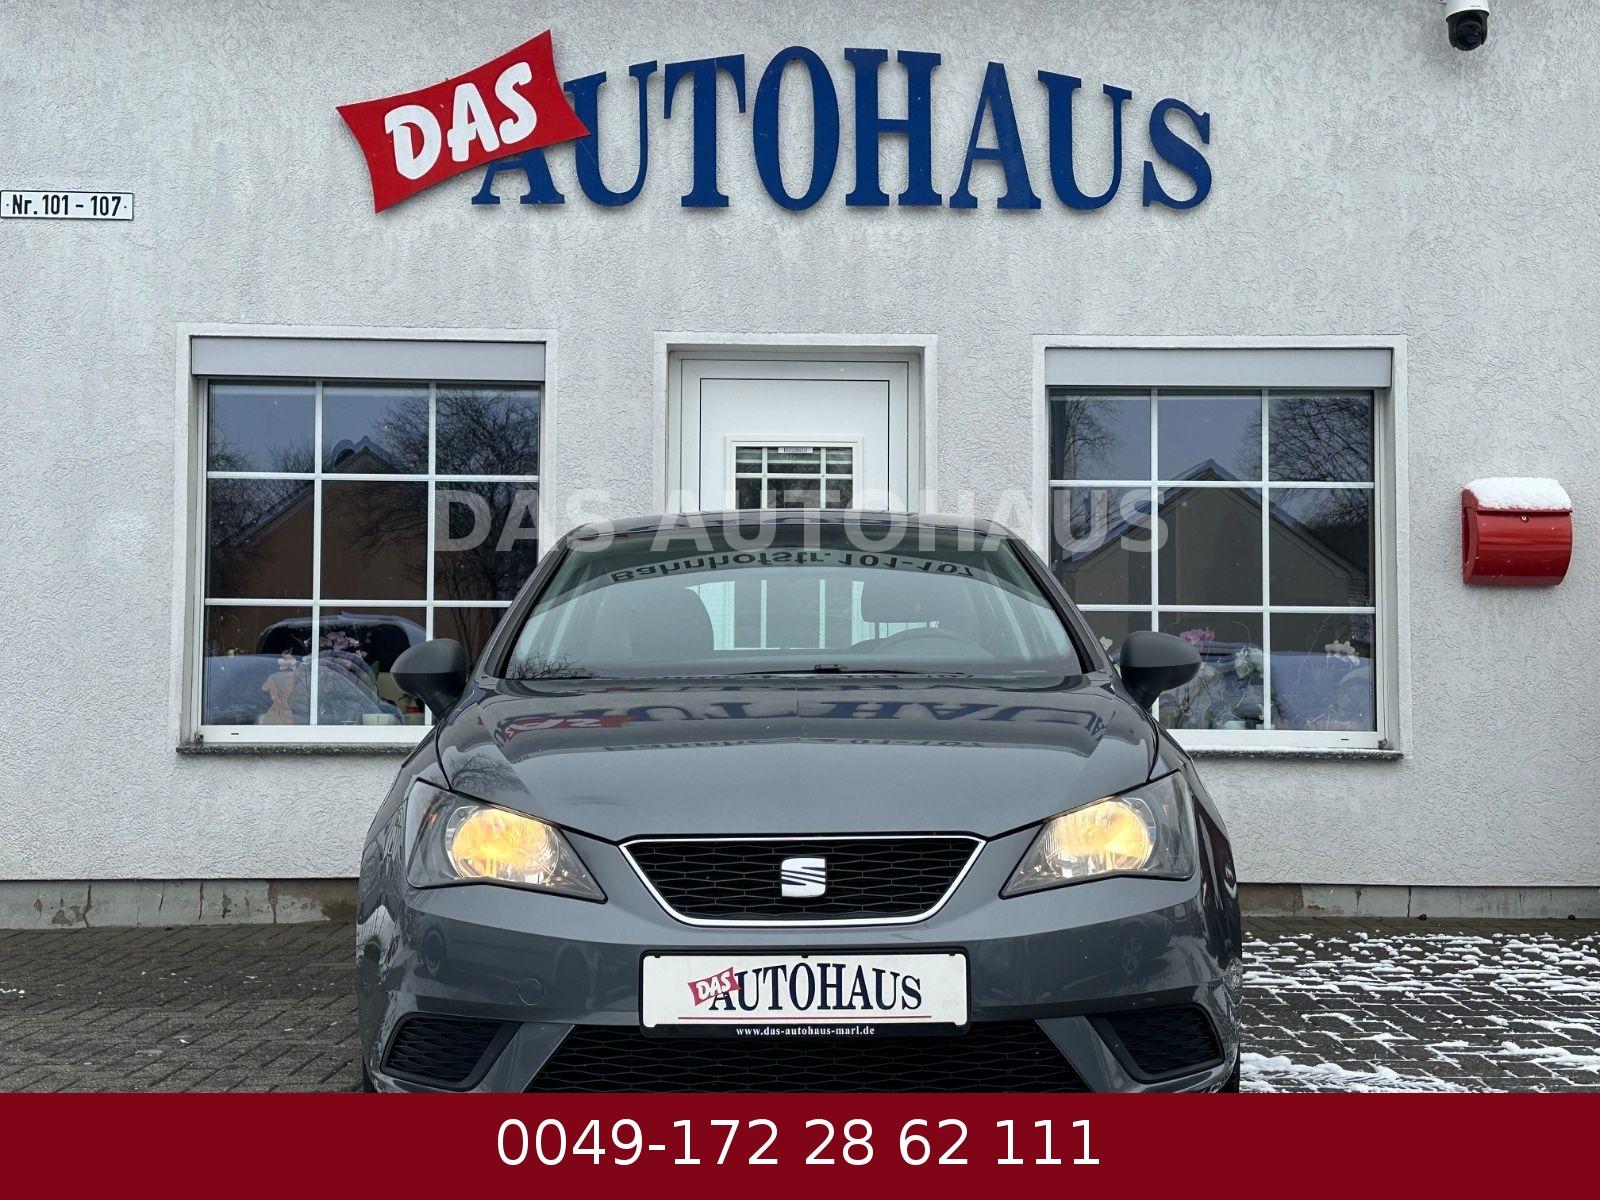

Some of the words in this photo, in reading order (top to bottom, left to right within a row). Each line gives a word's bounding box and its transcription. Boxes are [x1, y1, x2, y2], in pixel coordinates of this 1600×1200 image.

[384, 61, 537, 180] DAS
[90, 195, 122, 216] 107
[695, 971, 732, 1001] DAS
[735, 1026, 876, 1036] www.das-autohaus-marl.de
